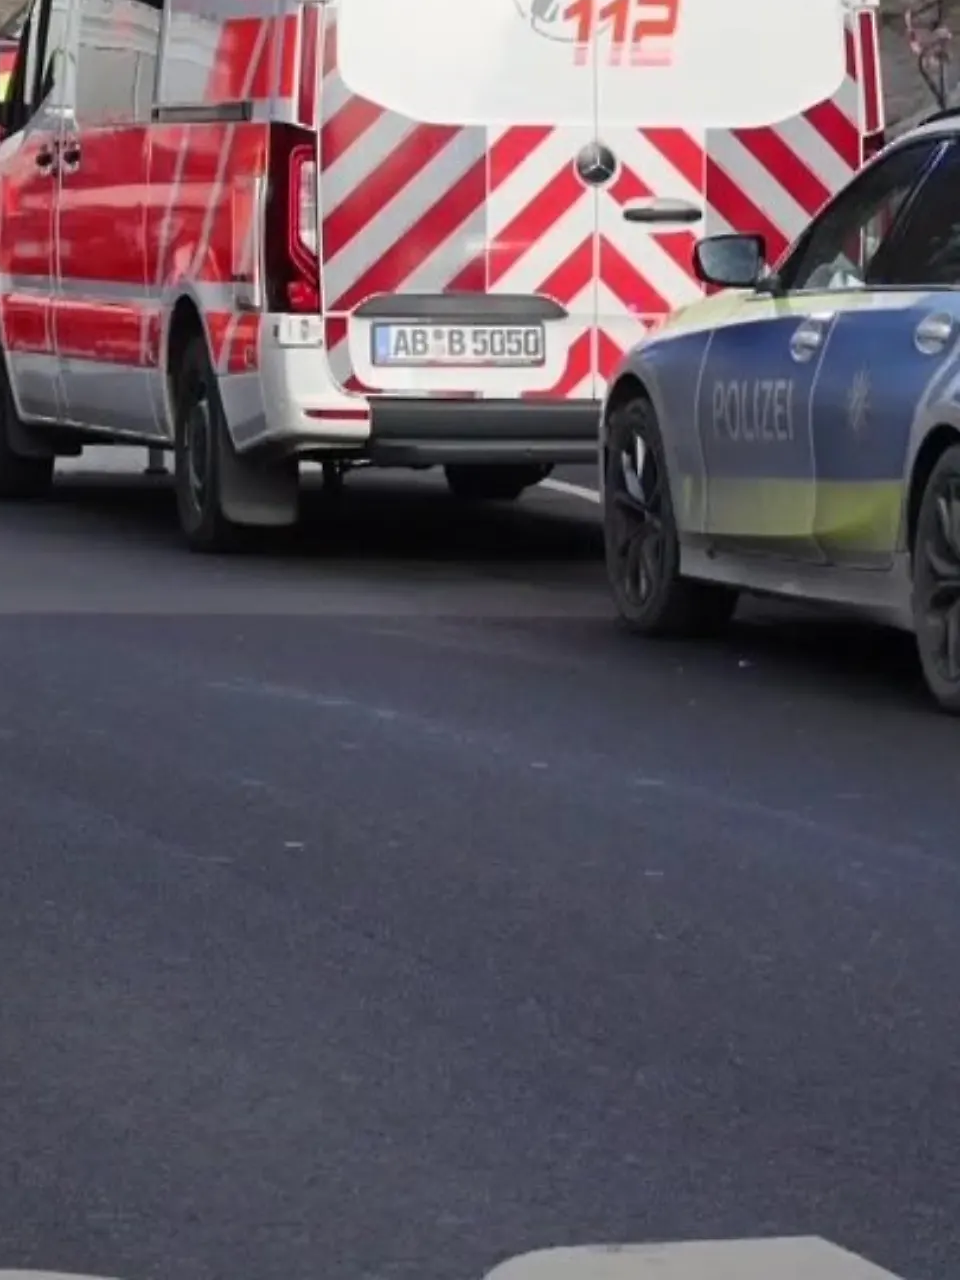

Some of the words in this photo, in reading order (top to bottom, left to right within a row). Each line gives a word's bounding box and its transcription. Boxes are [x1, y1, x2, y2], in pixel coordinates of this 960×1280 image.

[393, 329, 429, 357] AB
[447, 329, 466, 357] B
[472, 329, 540, 357] 5050
[712, 378, 796, 442] POLIZEI
